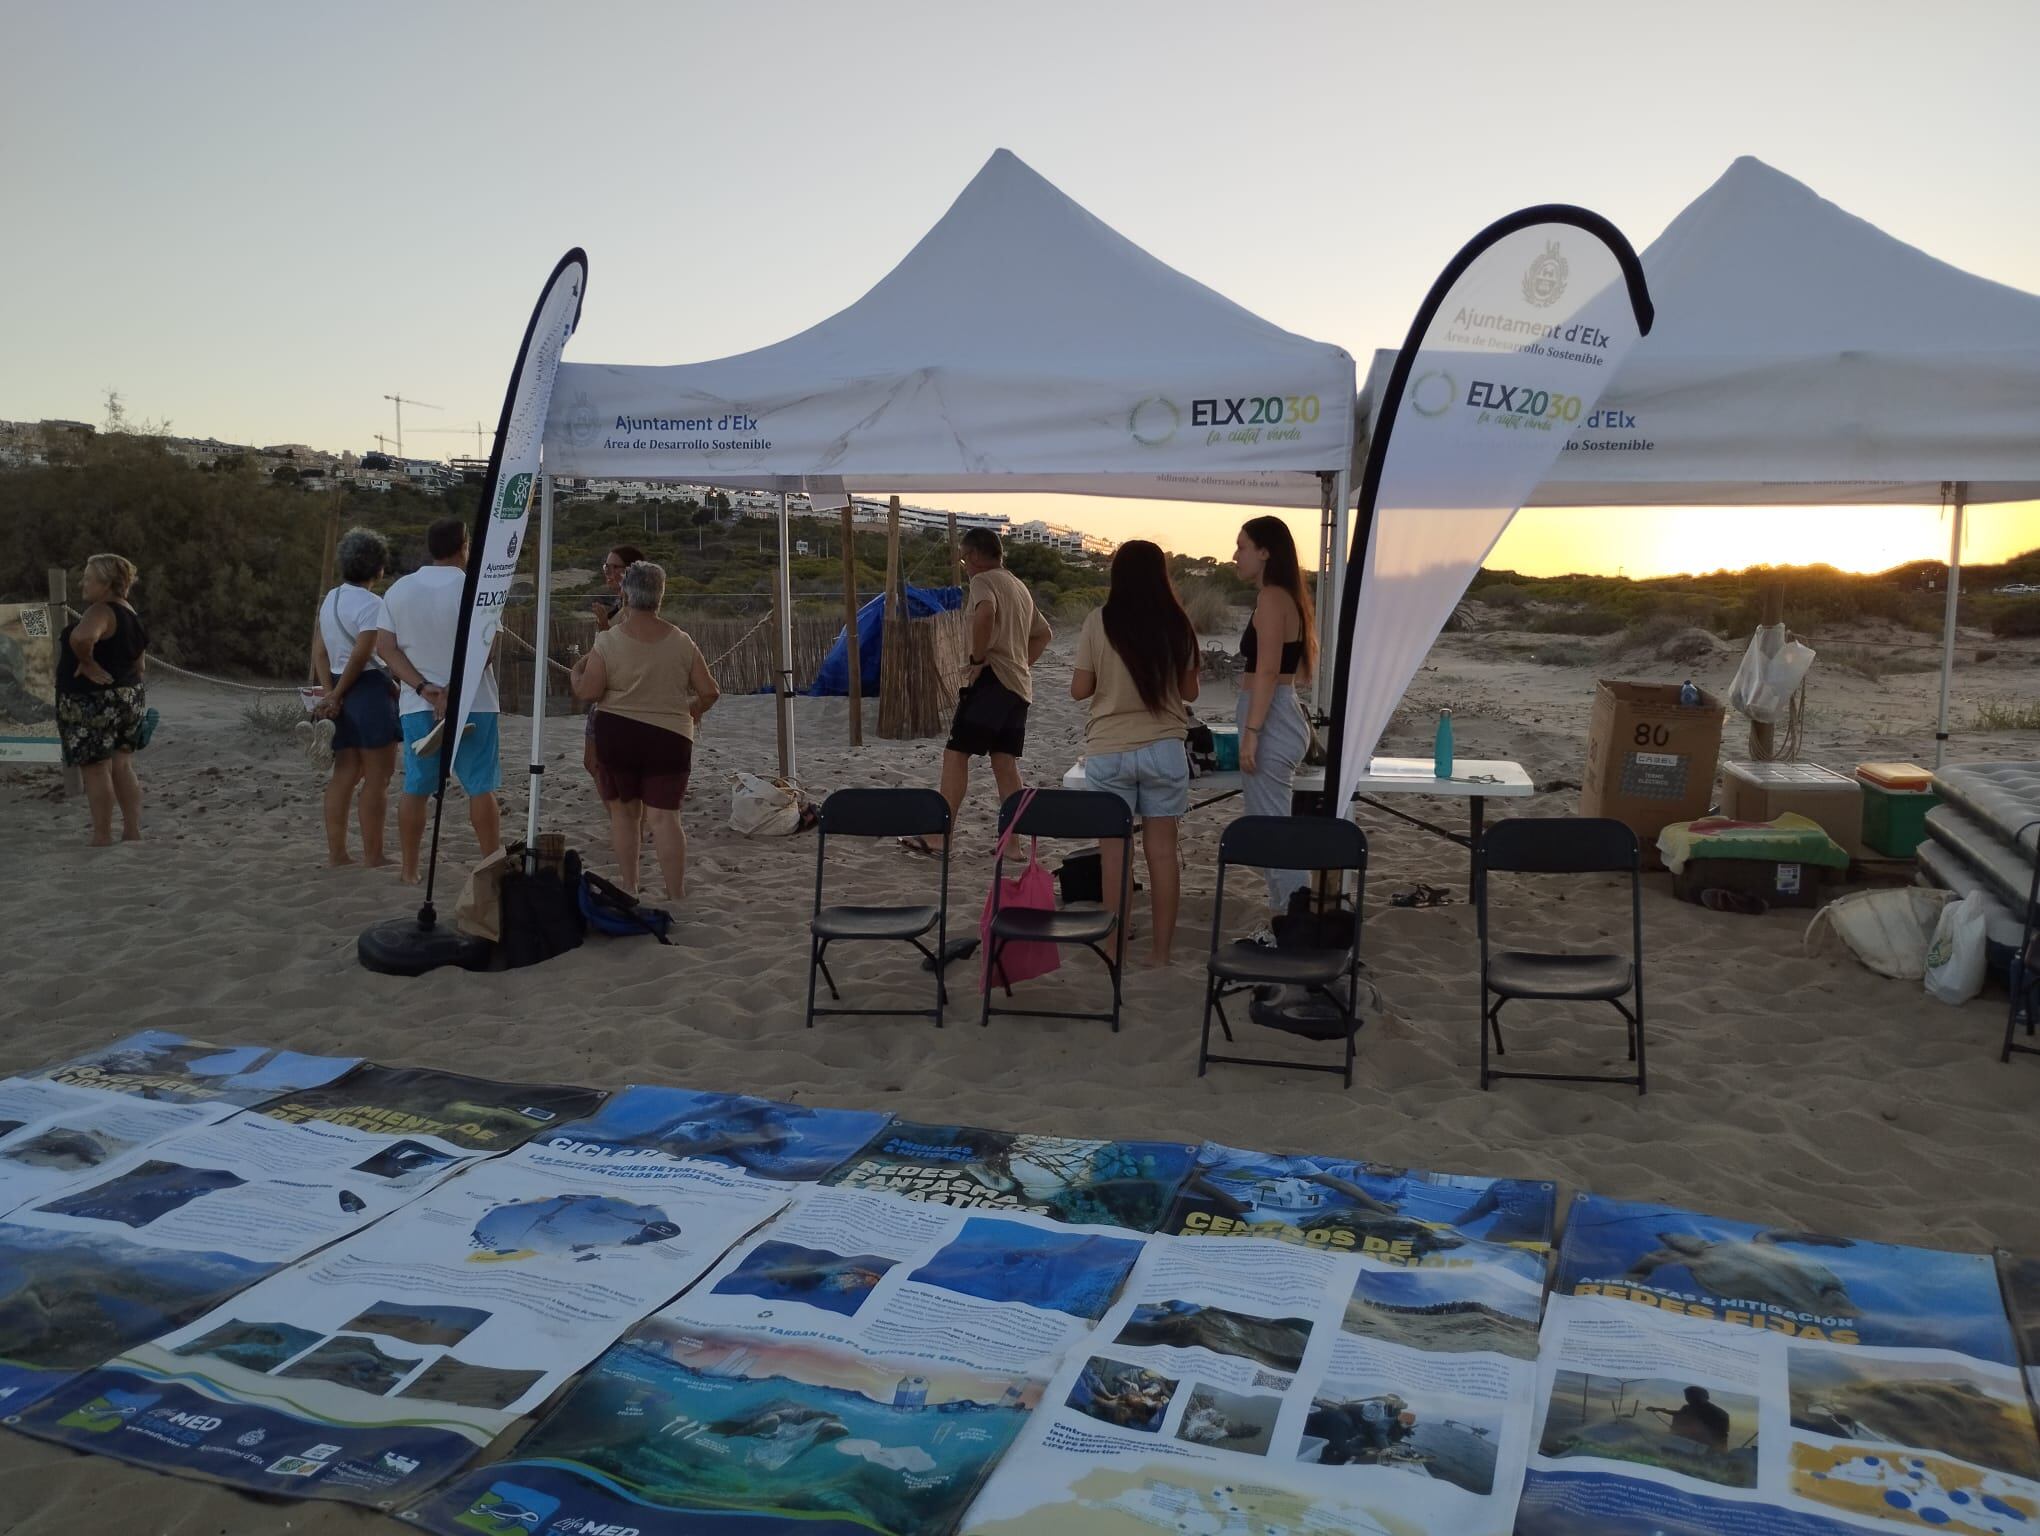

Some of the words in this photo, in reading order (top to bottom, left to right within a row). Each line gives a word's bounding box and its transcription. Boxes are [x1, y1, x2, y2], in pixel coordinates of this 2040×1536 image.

[1454, 307, 1561, 340] Ajuntament
[1487, 338, 1545, 356] Desarrollo
[1546, 347, 1604, 366] Sostenible
[1192, 394, 1320, 427] ELX2030
[1466, 381, 1582, 421] ELX2030
[616, 415, 713, 434] Ajuntament
[717, 415, 760, 431] d'Elx
[604, 437, 630, 449] Área
[633, 439, 647, 449] de
[649, 439, 710, 449] Desarrollo
[712, 439, 772, 450] Sostenible
[1582, 439, 1654, 450] Sostenible
[1634, 723, 1670, 747] 80
[607, 1169, 652, 1178] CICLOS
[653, 1171, 670, 1179] DE
[671, 1172, 701, 1180] VIDA
[650, 1164, 667, 1172] DE
[855, 1160, 962, 1179] REDES
[846, 1169, 1018, 1205] FANTASMA
[1184, 1211, 1356, 1248] CENTROS
[1361, 1235, 1414, 1256] DE
[1574, 1284, 1715, 1319] REDES
[1724, 1309, 1861, 1345] FIJAS
[1721, 1298, 1853, 1328] MITIGACIÓN
[768, 1326, 818, 1338] TARDAN
[819, 1333, 845, 1342] LOS
[168, 1411, 222, 1431] MED
